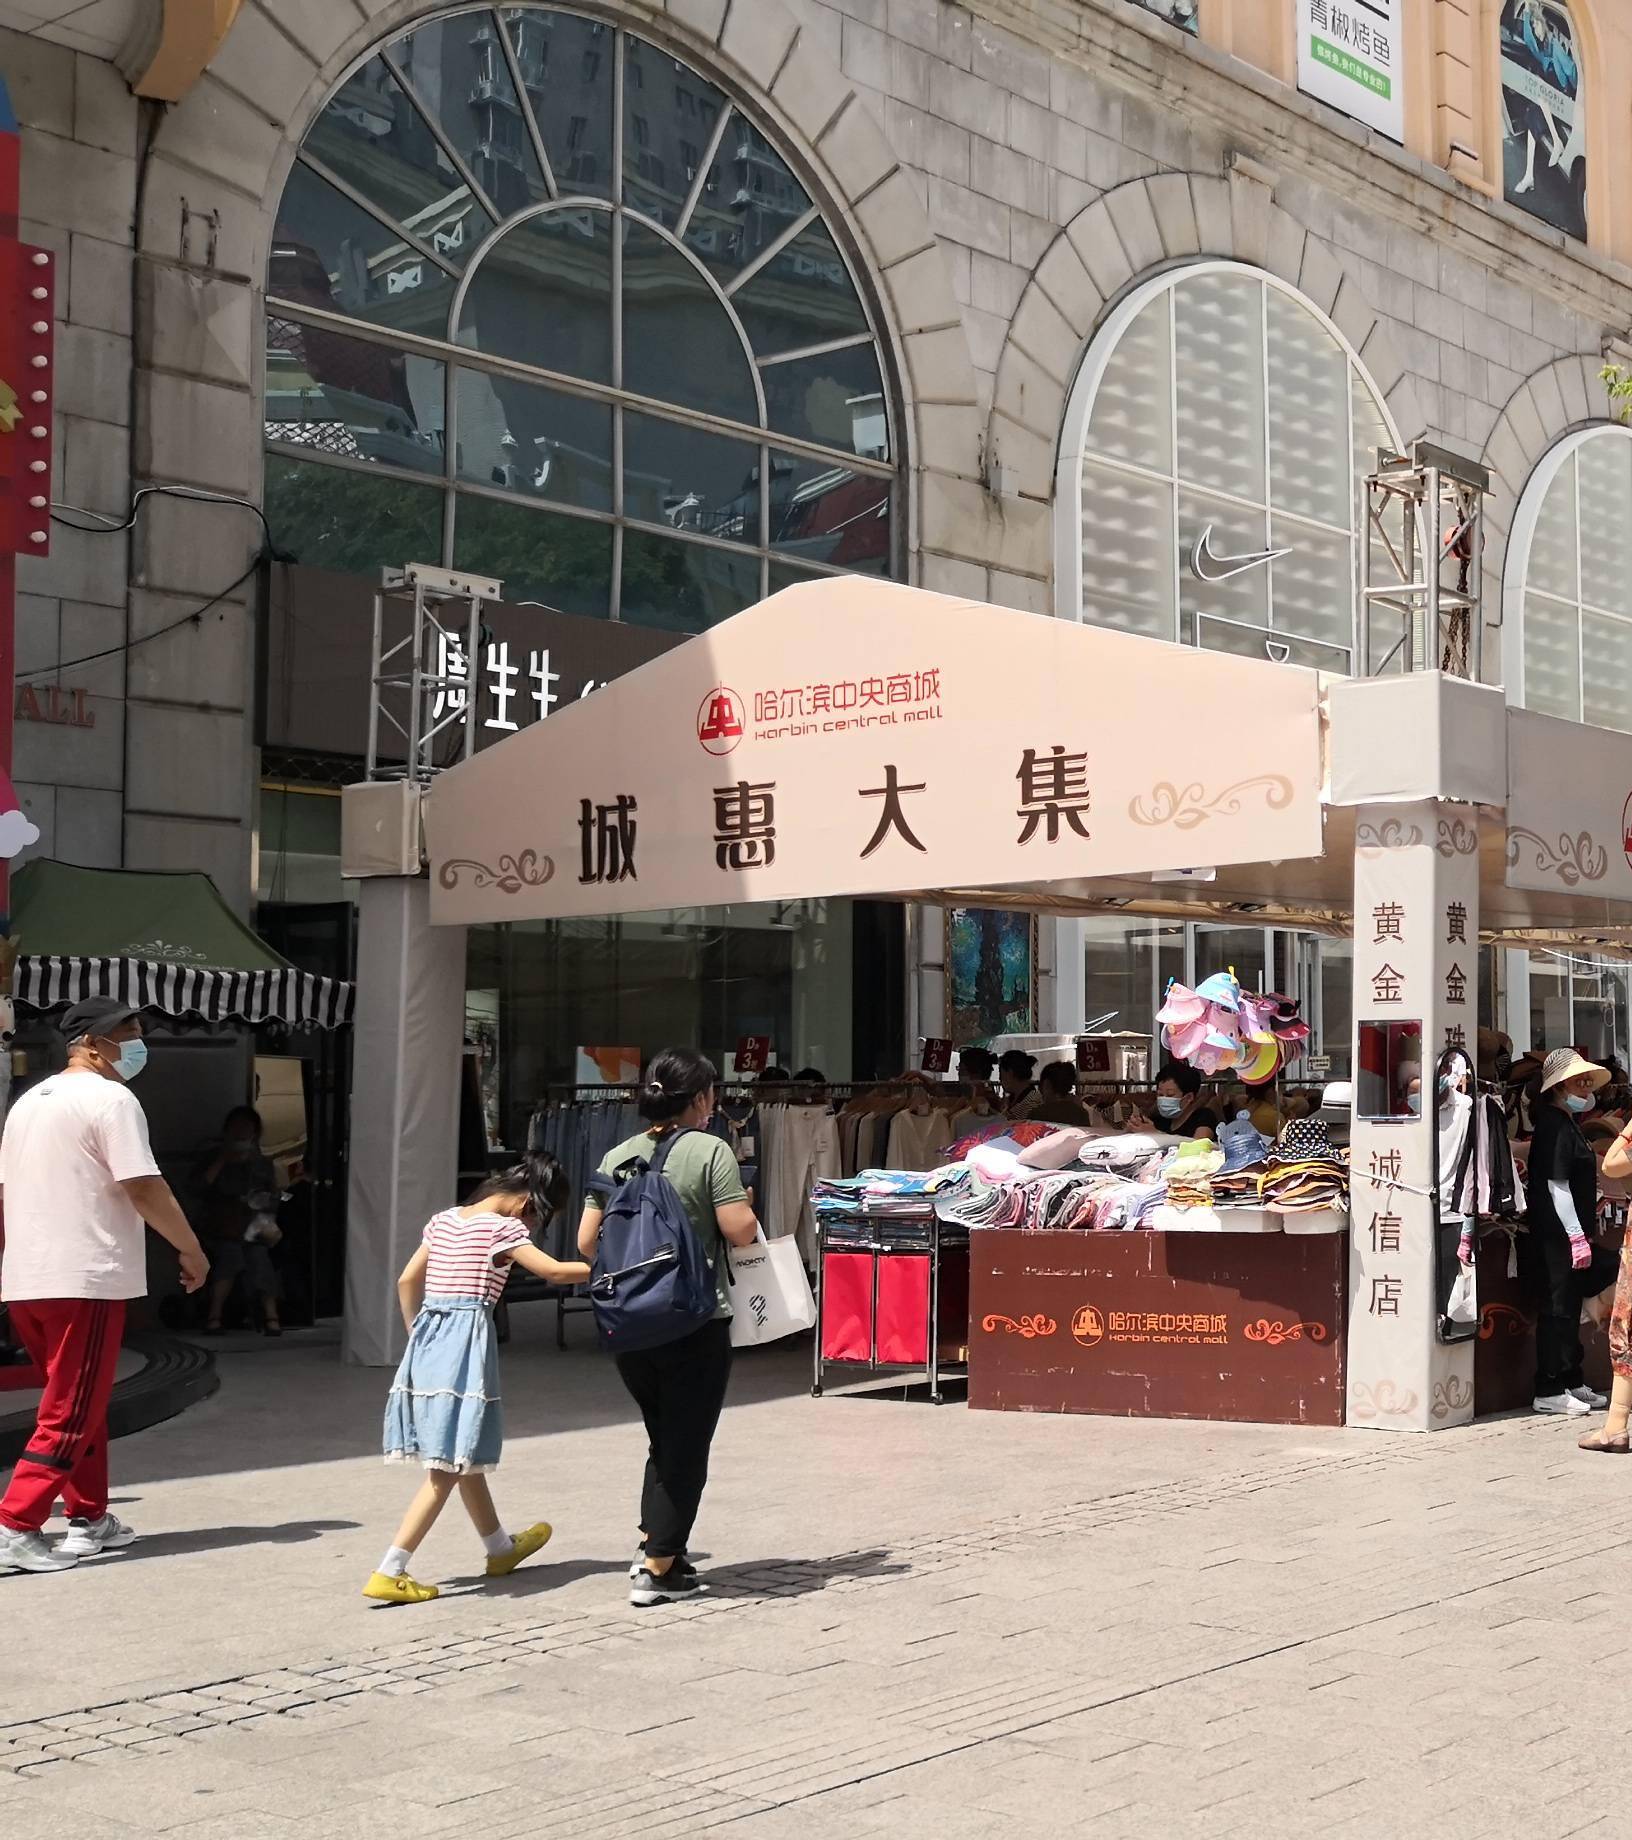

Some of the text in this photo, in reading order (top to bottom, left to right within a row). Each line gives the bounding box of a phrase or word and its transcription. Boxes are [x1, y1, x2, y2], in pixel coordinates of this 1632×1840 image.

[1310, 0, 1390, 67] 青椒烤鱼
[433, 631, 561, 731] 周生生
[754, 668, 941, 723] 哈尔滨中央商城
[755, 705, 943, 741] Harbin central mall
[577, 745, 1092, 885] 城惠大集
[1108, 1312, 1227, 1333] 哈尔滨中央商城
[1153, 1334, 1200, 1344] central
[1203, 1335, 1228, 1344] mall
